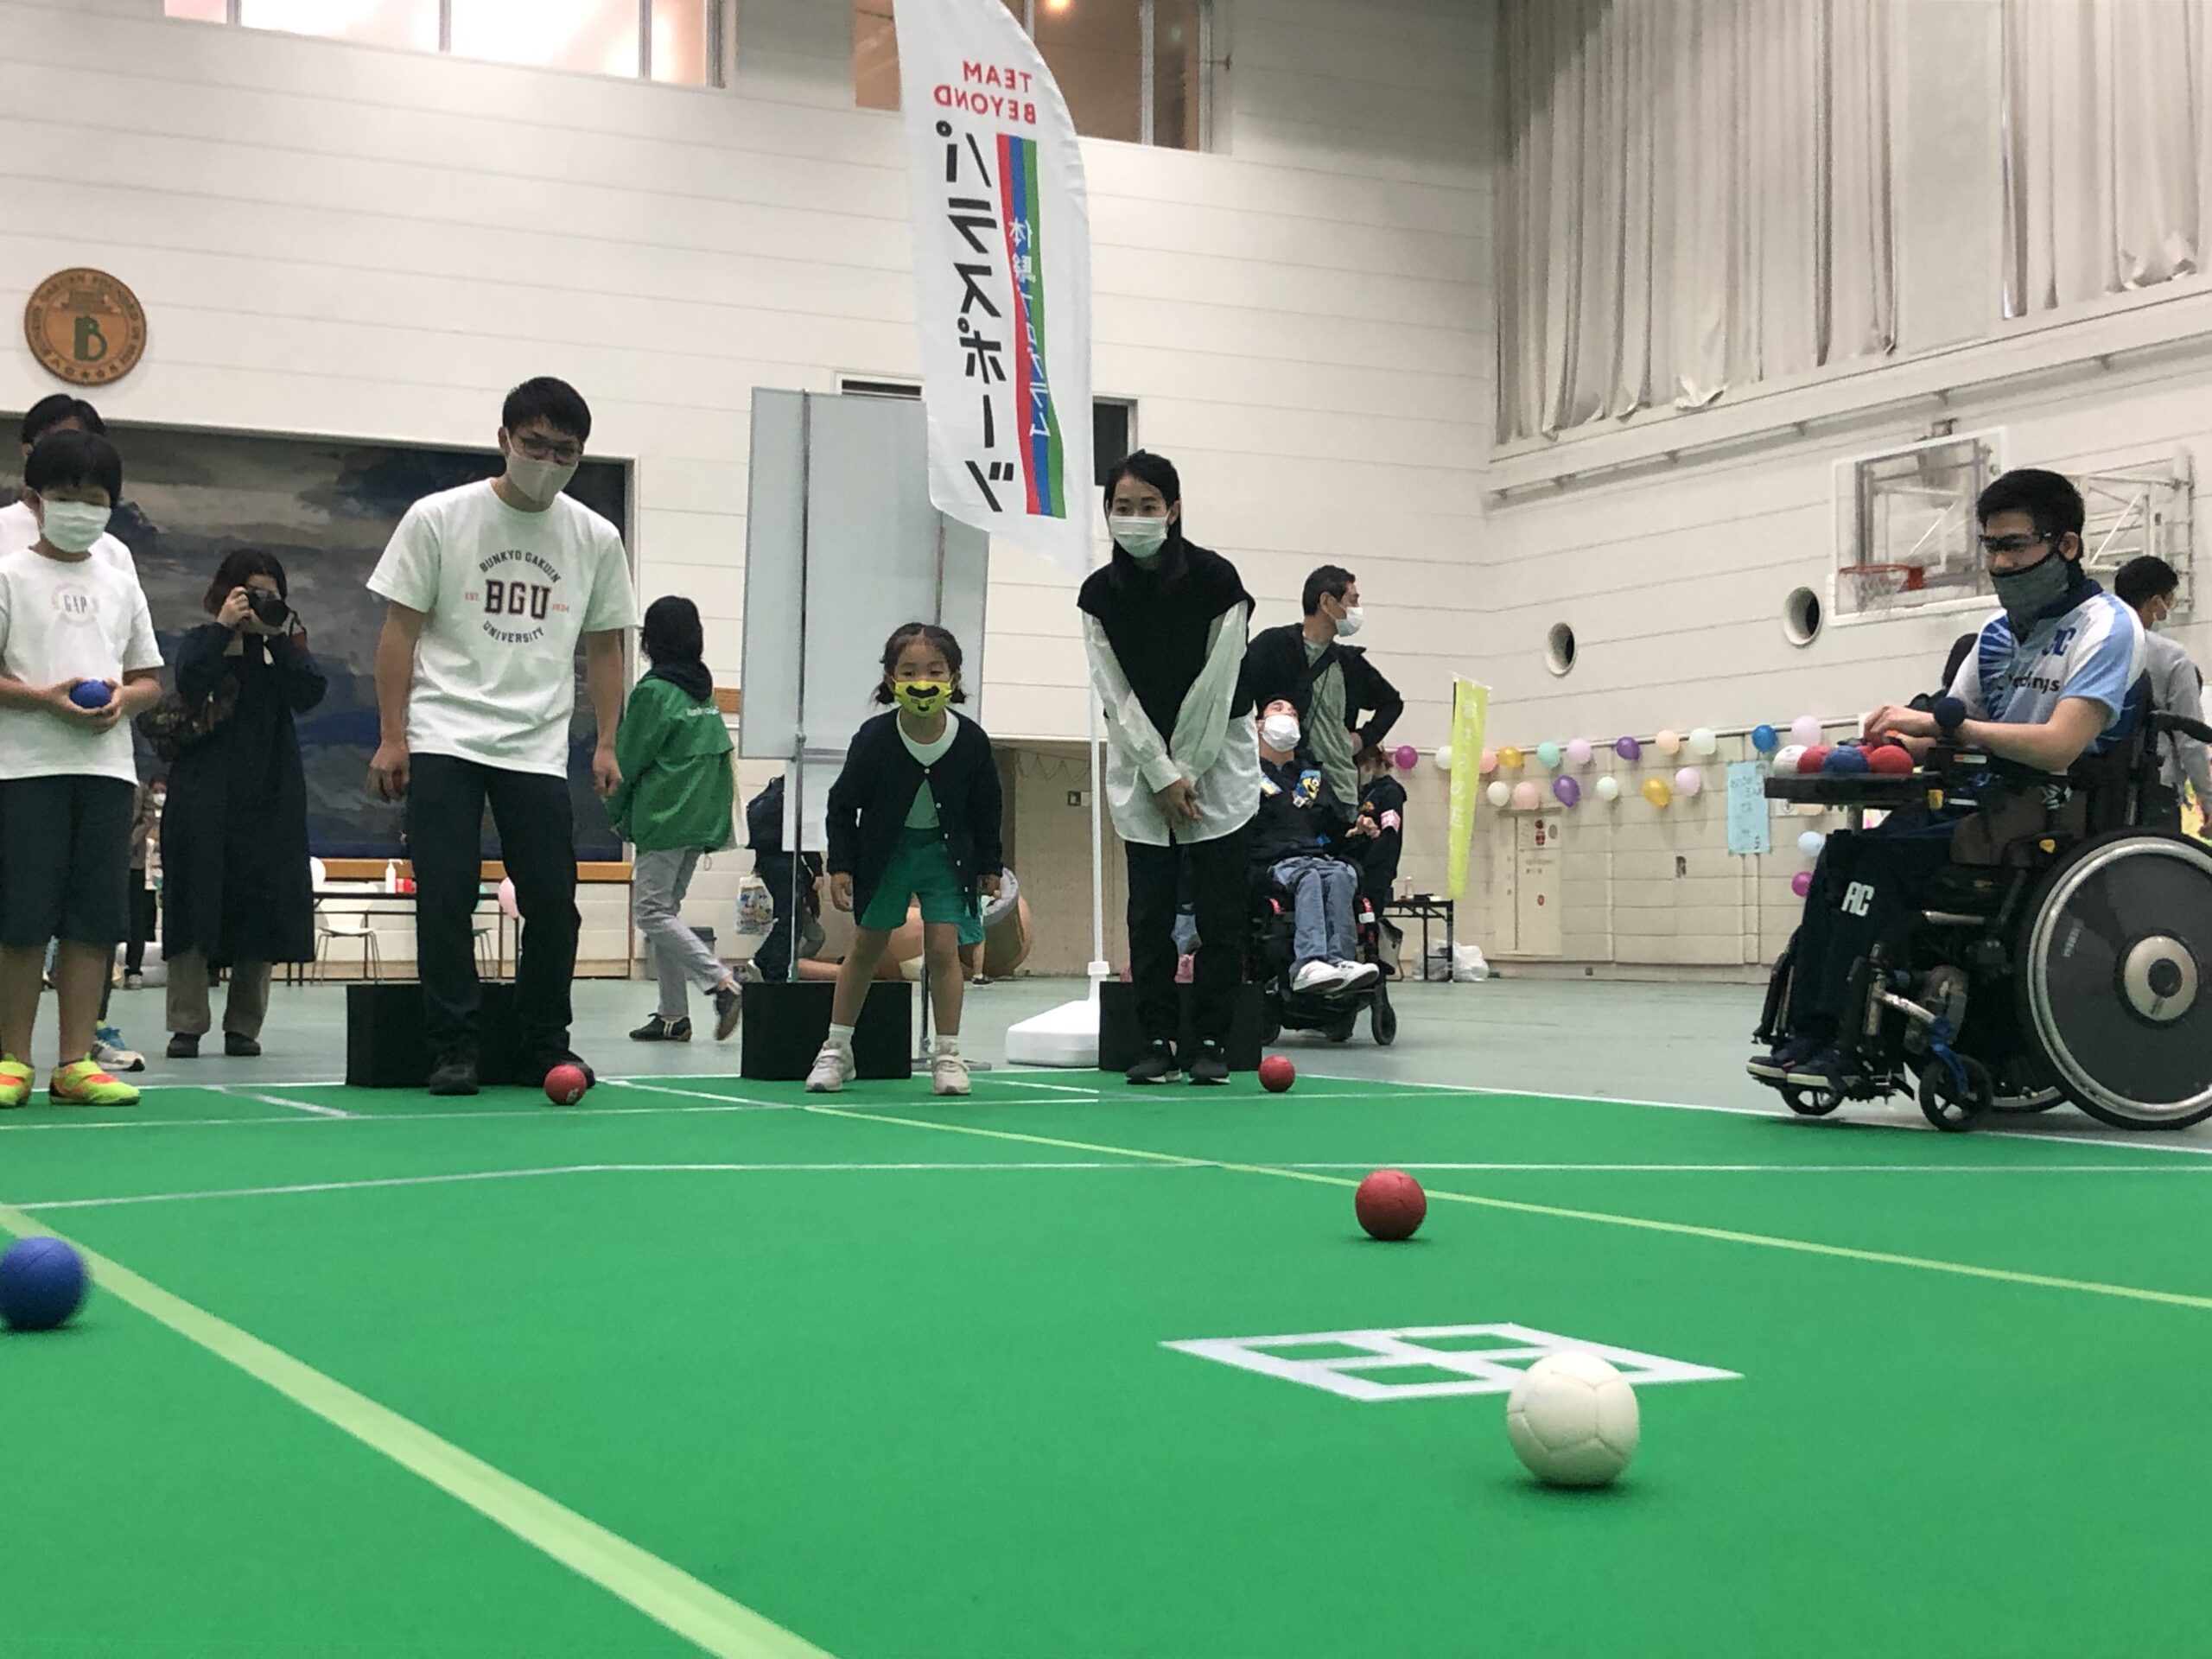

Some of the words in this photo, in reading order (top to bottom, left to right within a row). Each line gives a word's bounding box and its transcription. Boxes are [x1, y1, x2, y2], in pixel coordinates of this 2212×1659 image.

[479, 550, 523, 573] BUNKYO
[524, 551, 562, 583] GAKUIN
[484, 578, 551, 620] BGU
[483, 620, 544, 644] UNIVERSITY
[1840, 880, 1875, 917] AC
